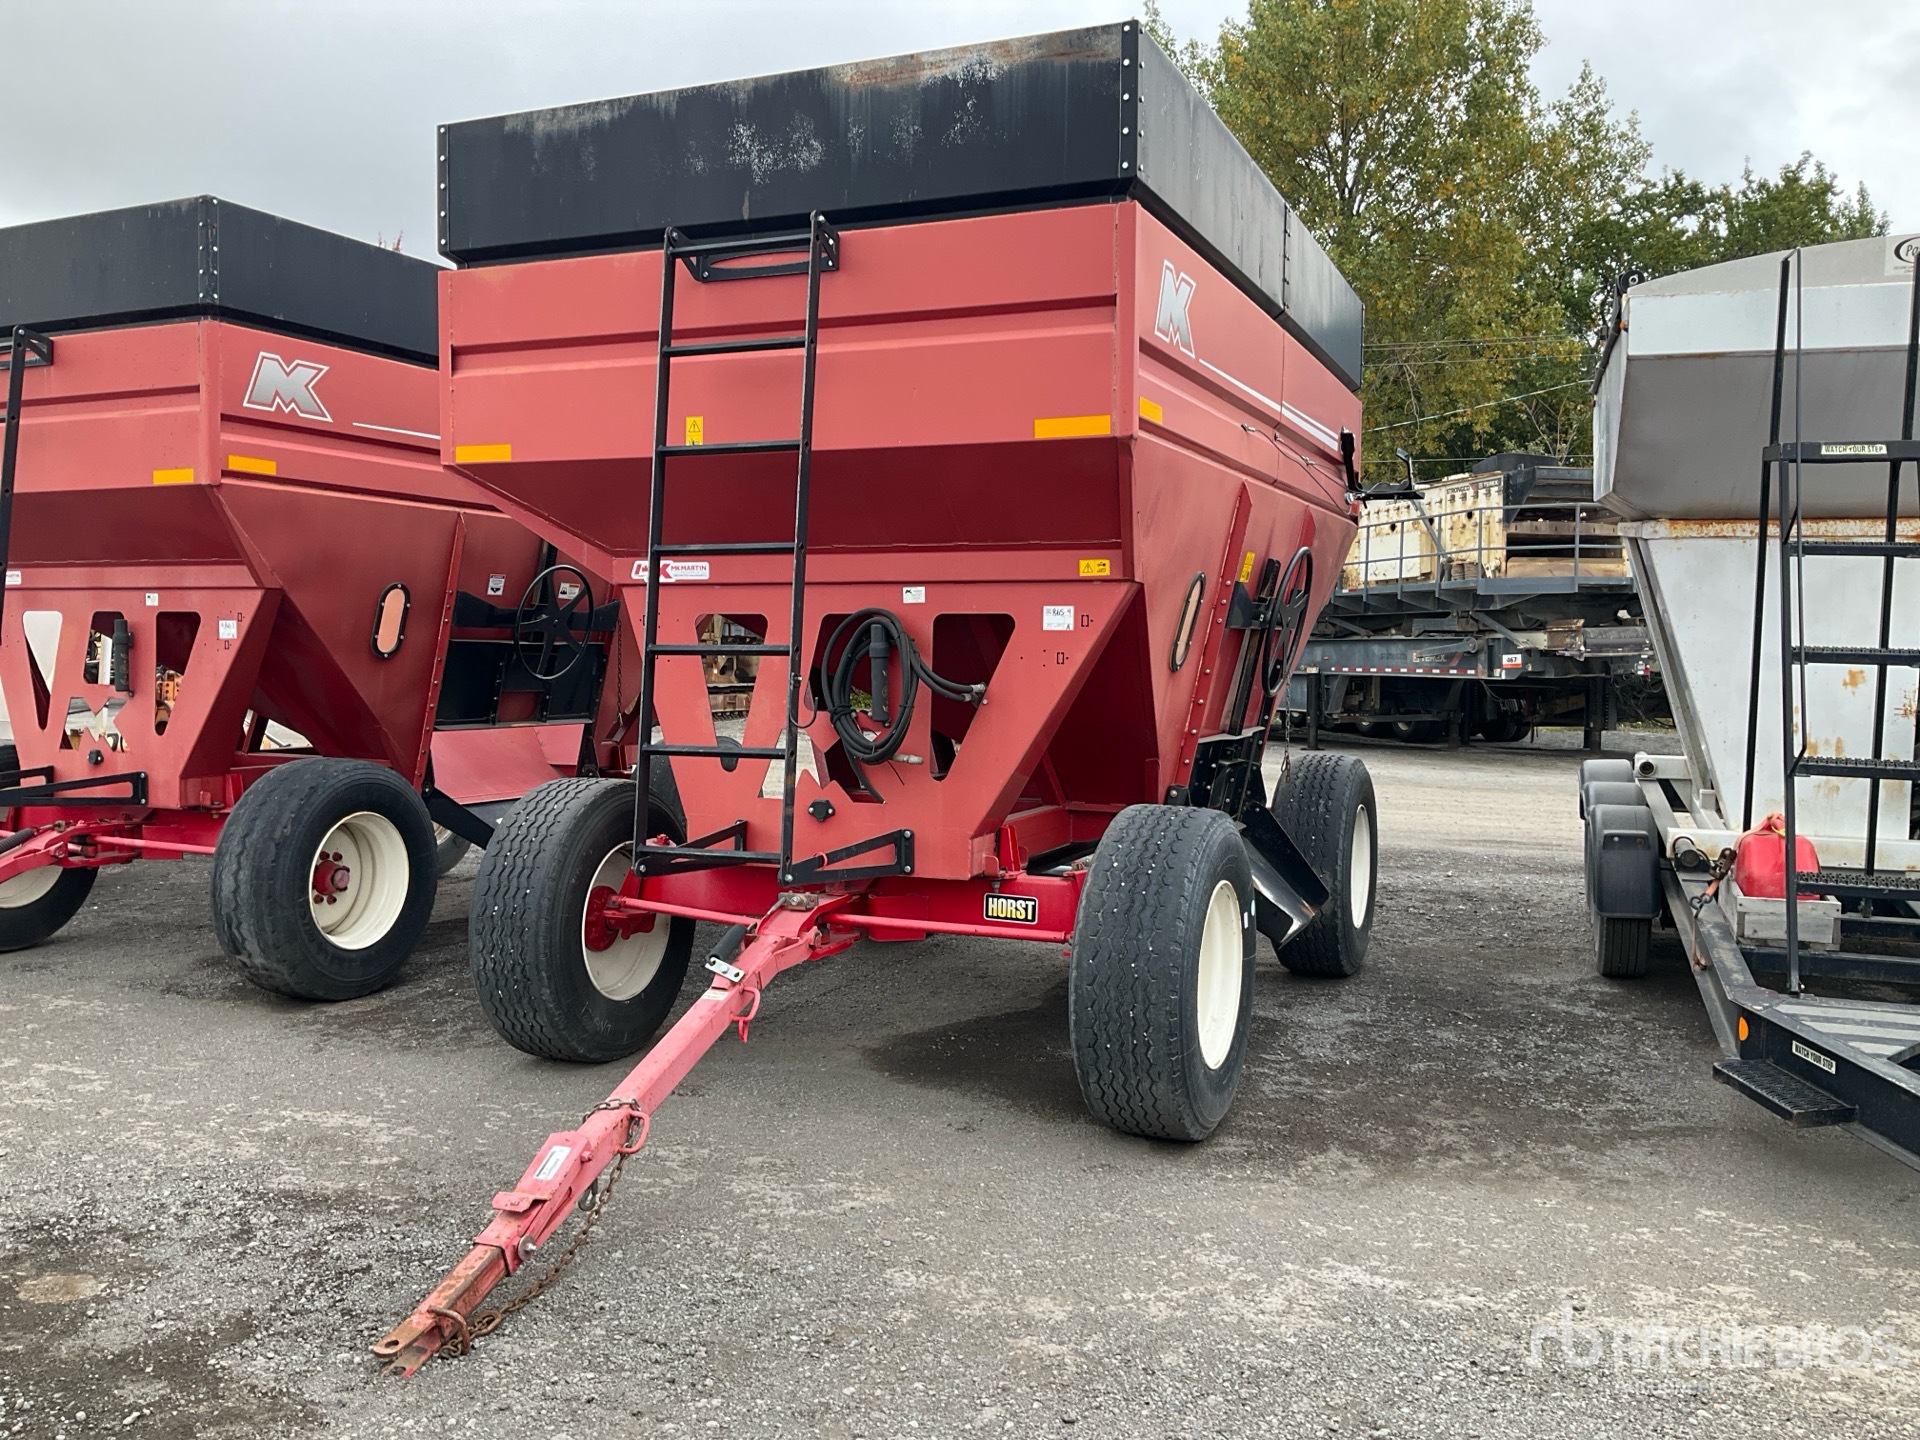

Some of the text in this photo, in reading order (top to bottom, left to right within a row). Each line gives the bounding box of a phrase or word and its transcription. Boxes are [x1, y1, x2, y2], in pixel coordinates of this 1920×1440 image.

[1824, 445, 1884, 453] WATCH YOUR STEP
[988, 897, 1035, 920] HORST
[1822, 1057, 1834, 1071] STEP
